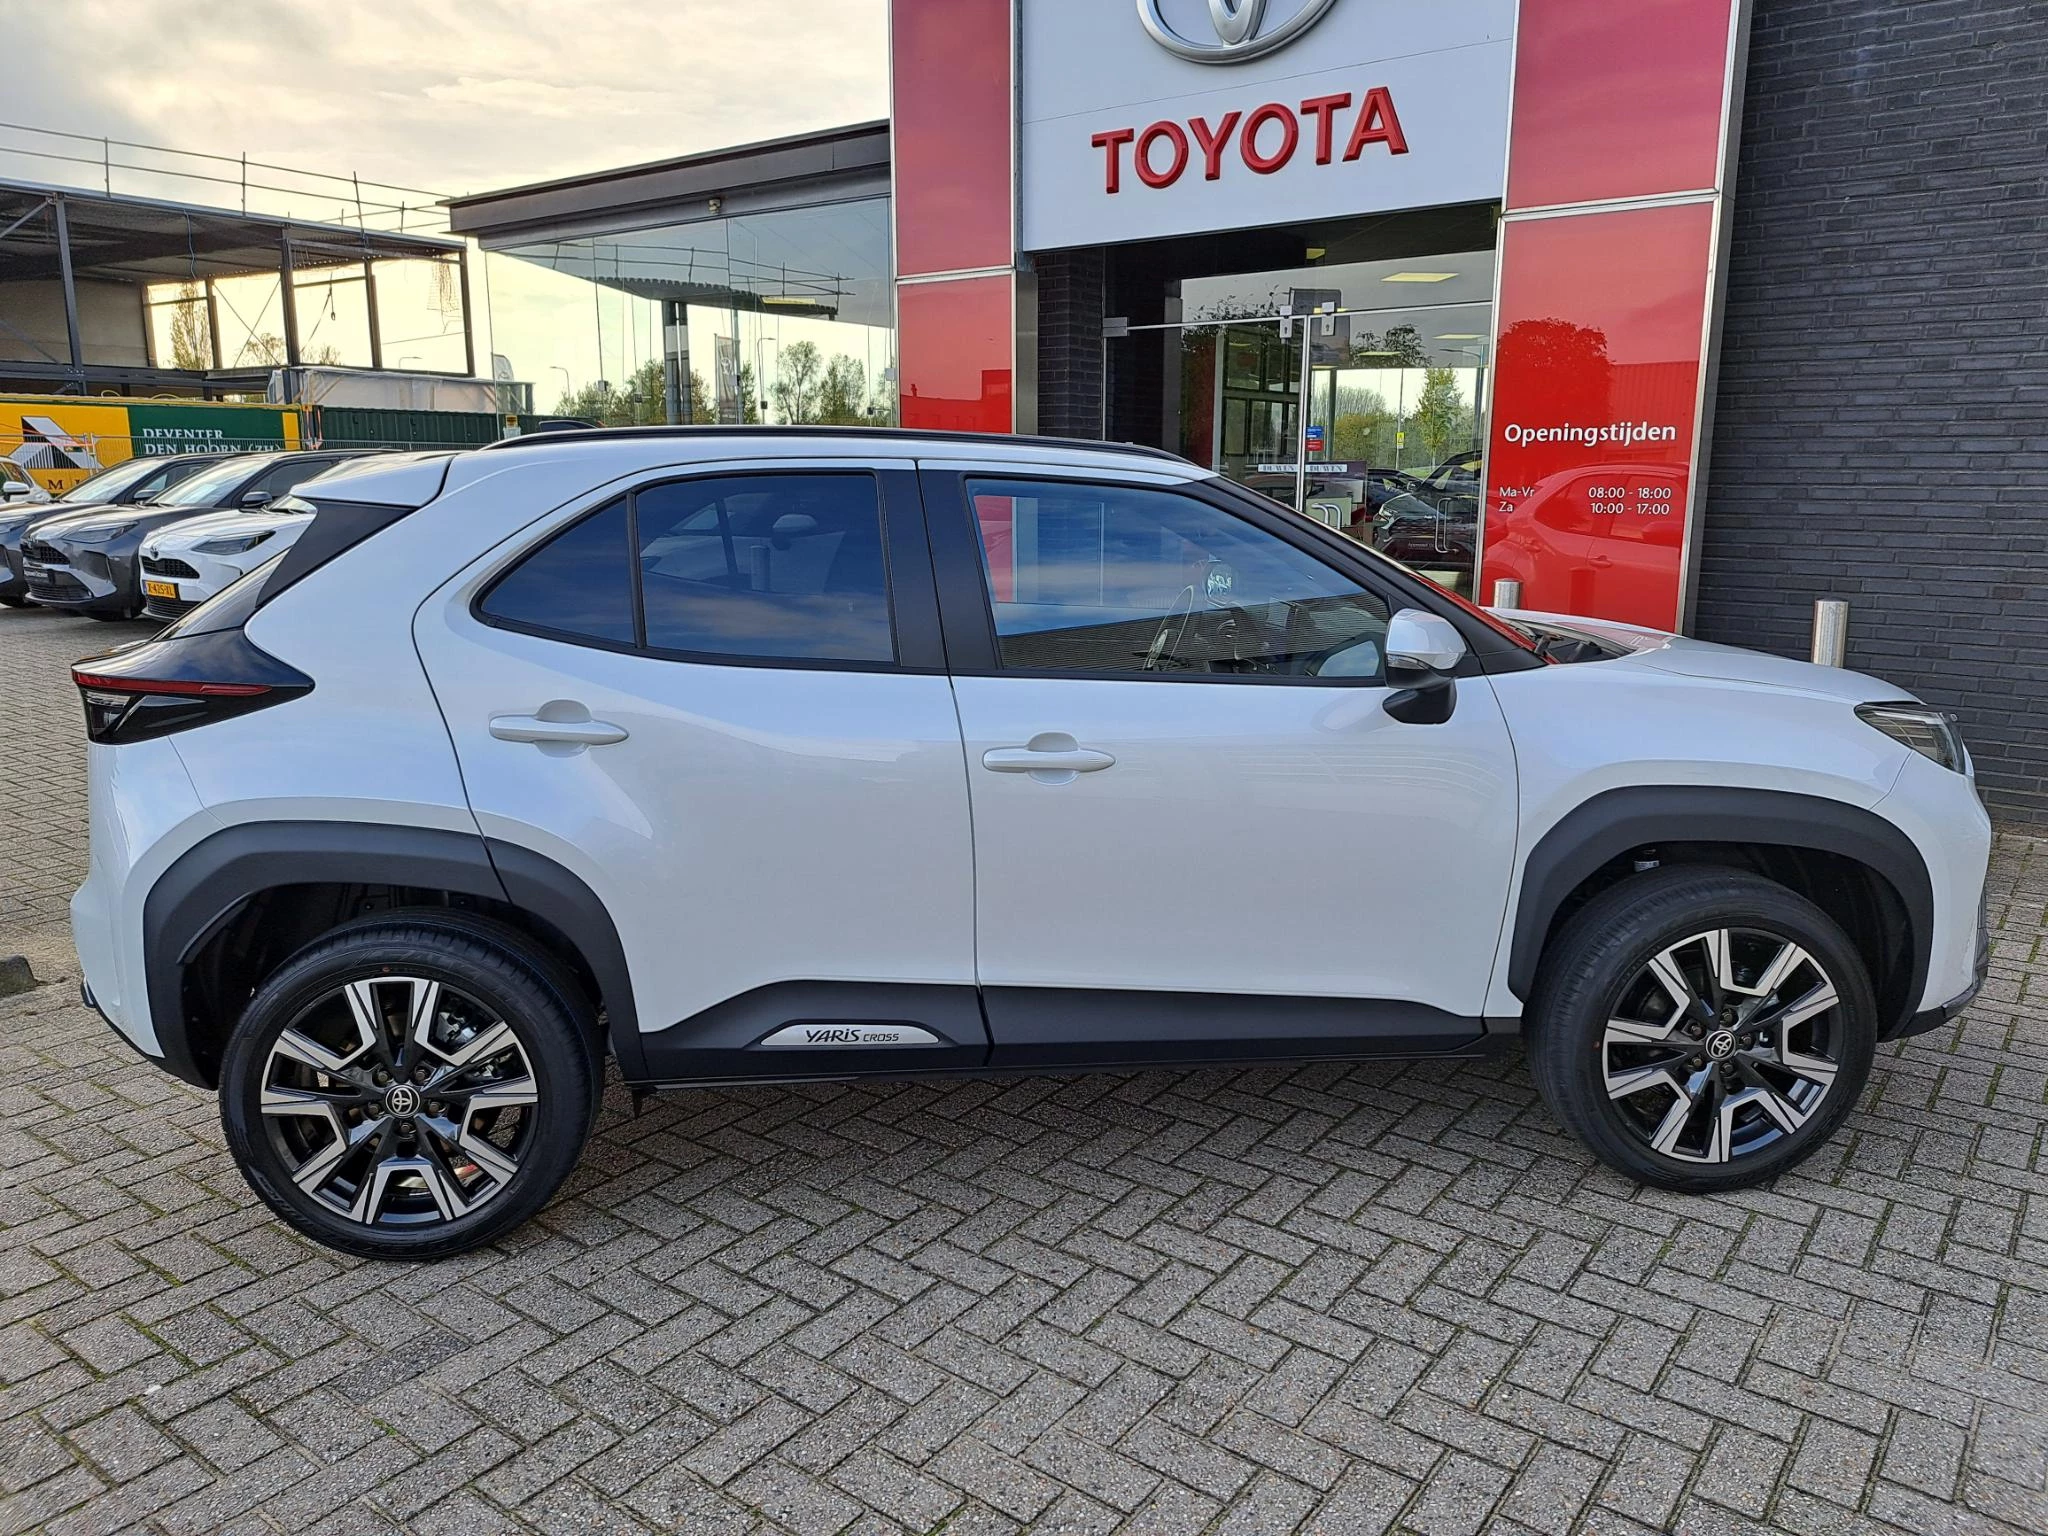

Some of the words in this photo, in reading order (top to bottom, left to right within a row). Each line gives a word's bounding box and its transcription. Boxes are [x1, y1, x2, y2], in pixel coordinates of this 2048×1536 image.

[1091, 86, 1409, 194] TOYOTA
[142, 428, 223, 439] DEVENTER
[1504, 421, 1677, 448] Openingstijden
[144, 443, 177, 454] DEN
[1499, 486, 1535, 497] Ma-Vr
[1588, 487, 1625, 499] 08:00
[1637, 487, 1672, 499] 18:00
[1498, 501, 1514, 512] Za
[1591, 502, 1624, 514] 10:00
[1636, 503, 1670, 515] 17:00
[862, 1033, 899, 1042] CROSS
